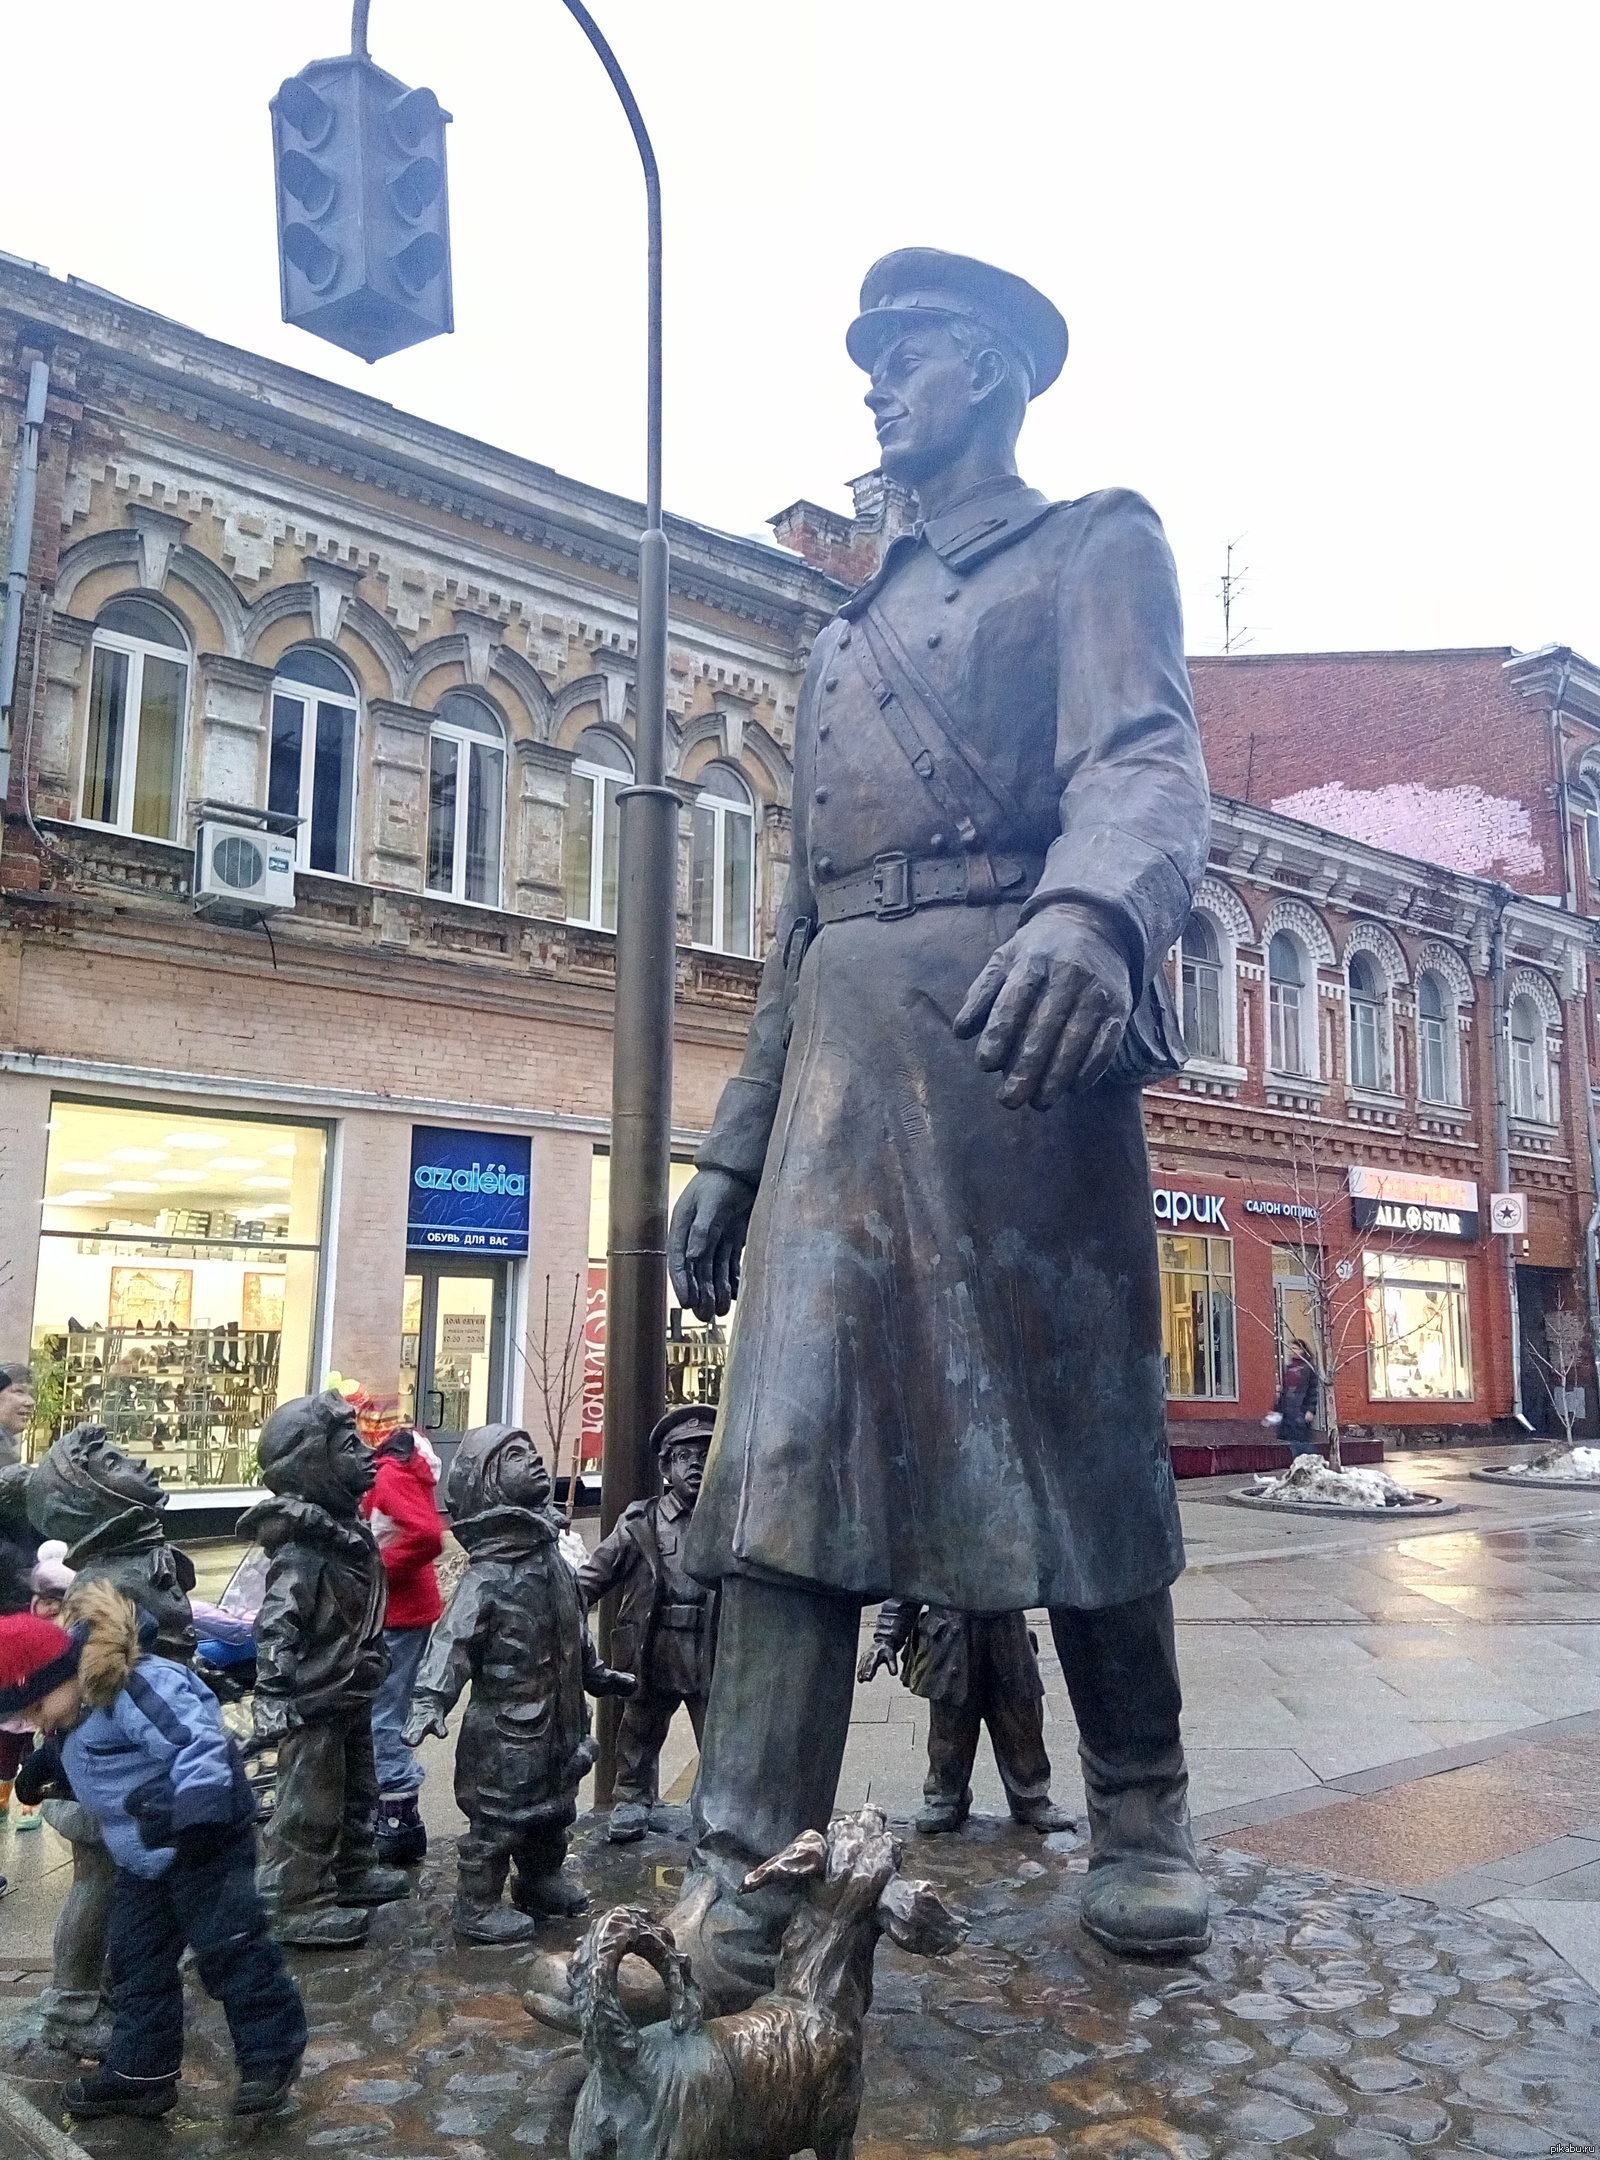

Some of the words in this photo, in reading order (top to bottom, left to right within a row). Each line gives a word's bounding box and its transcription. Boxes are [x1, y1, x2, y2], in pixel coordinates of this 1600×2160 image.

[414, 1162, 525, 1196] azaléia
[1153, 1189, 1230, 1232] арик
[1246, 1200, 1281, 1214] САЛОН
[1375, 1205, 1406, 1228] ALL
[1422, 1210, 1461, 1234] STAR
[427, 1232, 460, 1243] ОБУВЬ
[464, 1234, 485, 1245] ДЛЯ
[489, 1236, 508, 1246] ВАС
